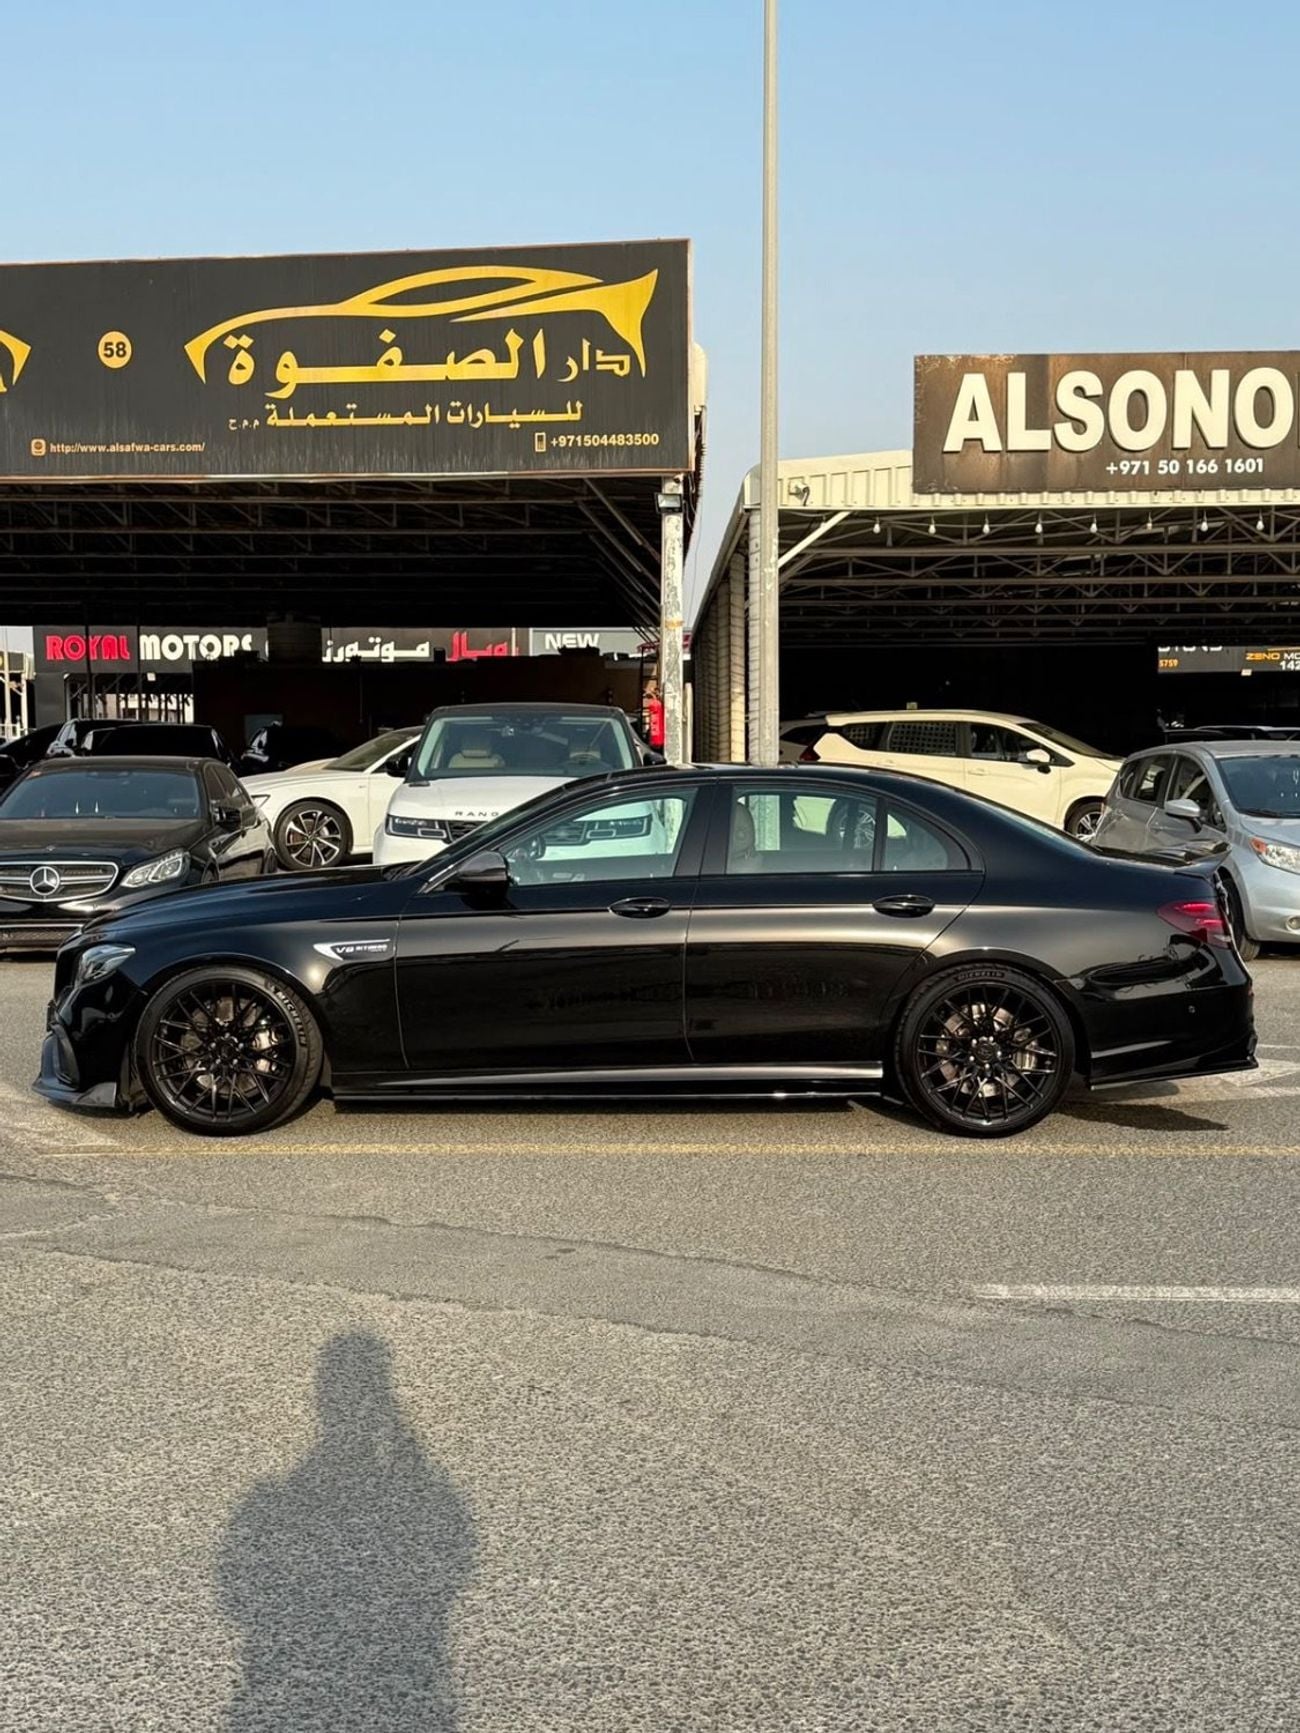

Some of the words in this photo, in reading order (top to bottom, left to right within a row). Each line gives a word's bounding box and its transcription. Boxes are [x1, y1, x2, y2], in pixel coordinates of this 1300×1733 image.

[103, 341, 127, 359] 58
[557, 338, 631, 382] دار
[223, 328, 546, 399] الصفوة
[264, 403, 440, 428] المستعملة
[446, 400, 583, 429] للسيارات
[942, 367, 1295, 454] ALSONO
[49, 442, 206, 455] http://www.alsafwa-cars.com/
[550, 433, 660, 447] +971504483500
[1105, 460, 1150, 475] +971
[1157, 459, 1180, 475] 50
[1186, 458, 1219, 474] 166
[1225, 457, 1264, 473] 1601
[45, 634, 131, 661] ROYAL
[544, 632, 600, 650] NEW
[1245, 652, 1281, 661] ZENO
